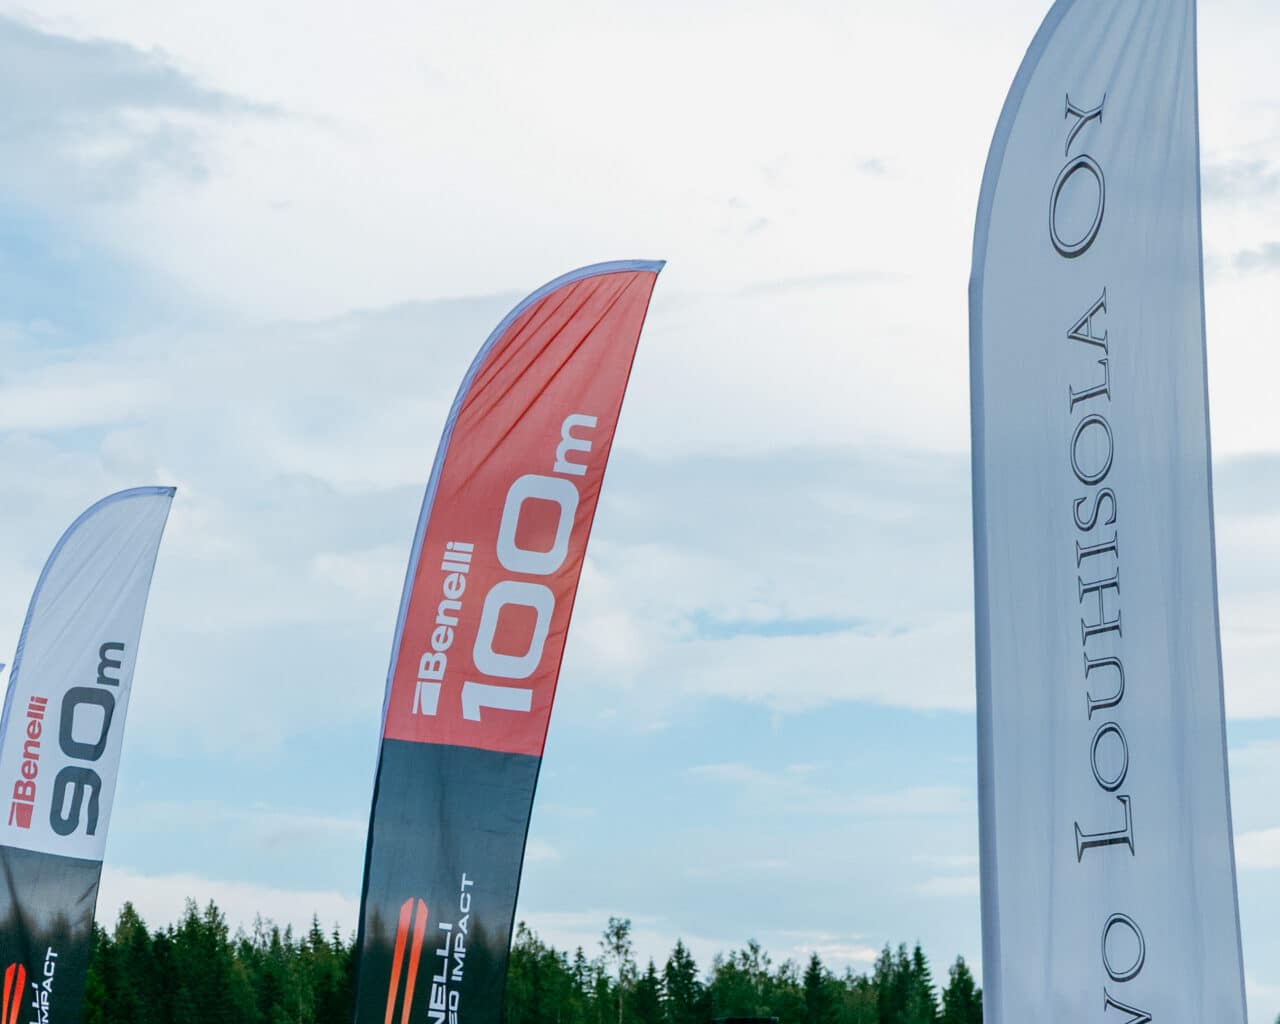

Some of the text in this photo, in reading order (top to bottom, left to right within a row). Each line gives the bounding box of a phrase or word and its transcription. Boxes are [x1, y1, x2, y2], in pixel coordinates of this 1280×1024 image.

[1049, 91, 1107, 259] OY
[417, 541, 474, 681] Benelli
[461, 413, 598, 722] 100m
[1066, 286, 1135, 864] LOUHISOLA
[13, 696, 49, 802] Benelli
[49, 641, 125, 836] 90m
[451, 873, 475, 982] IMPACT
